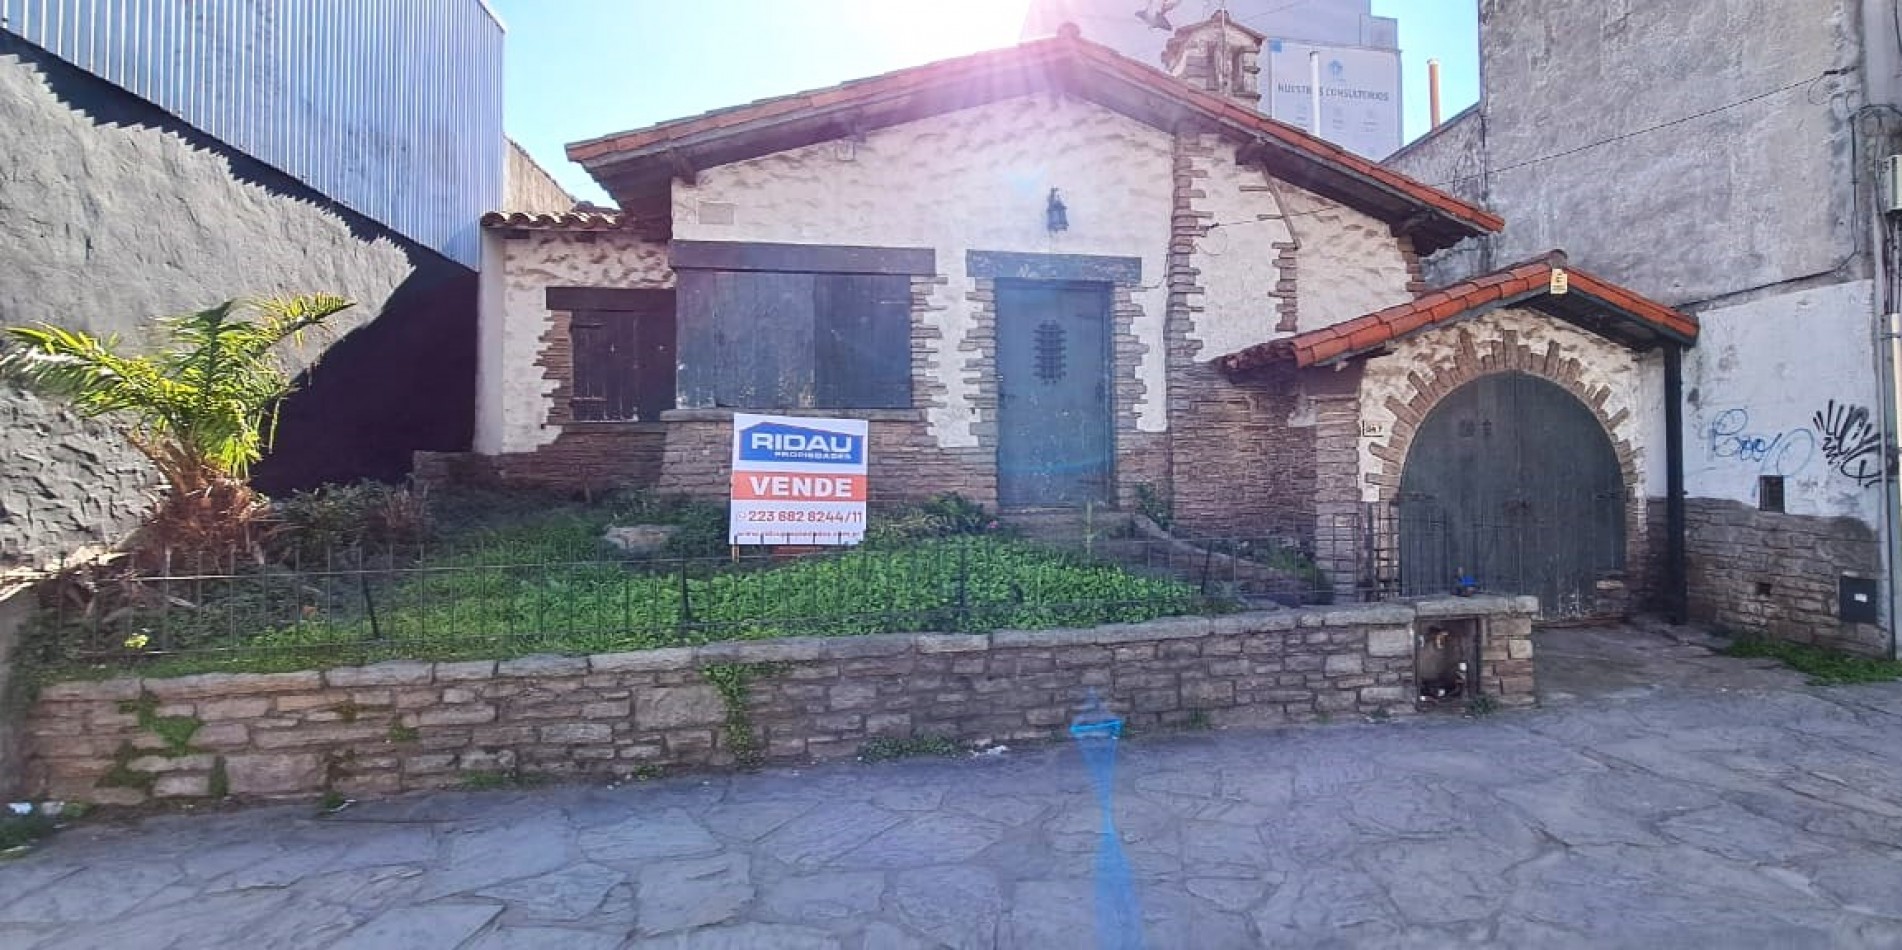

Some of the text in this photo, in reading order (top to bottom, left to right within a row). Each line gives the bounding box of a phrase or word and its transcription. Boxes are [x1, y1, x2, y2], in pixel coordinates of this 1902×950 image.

[1278, 83, 1324, 96] NUESTRS
[751, 433, 852, 453] RIDAU
[749, 476, 853, 498] VENDE
[748, 510, 775, 522] 223
